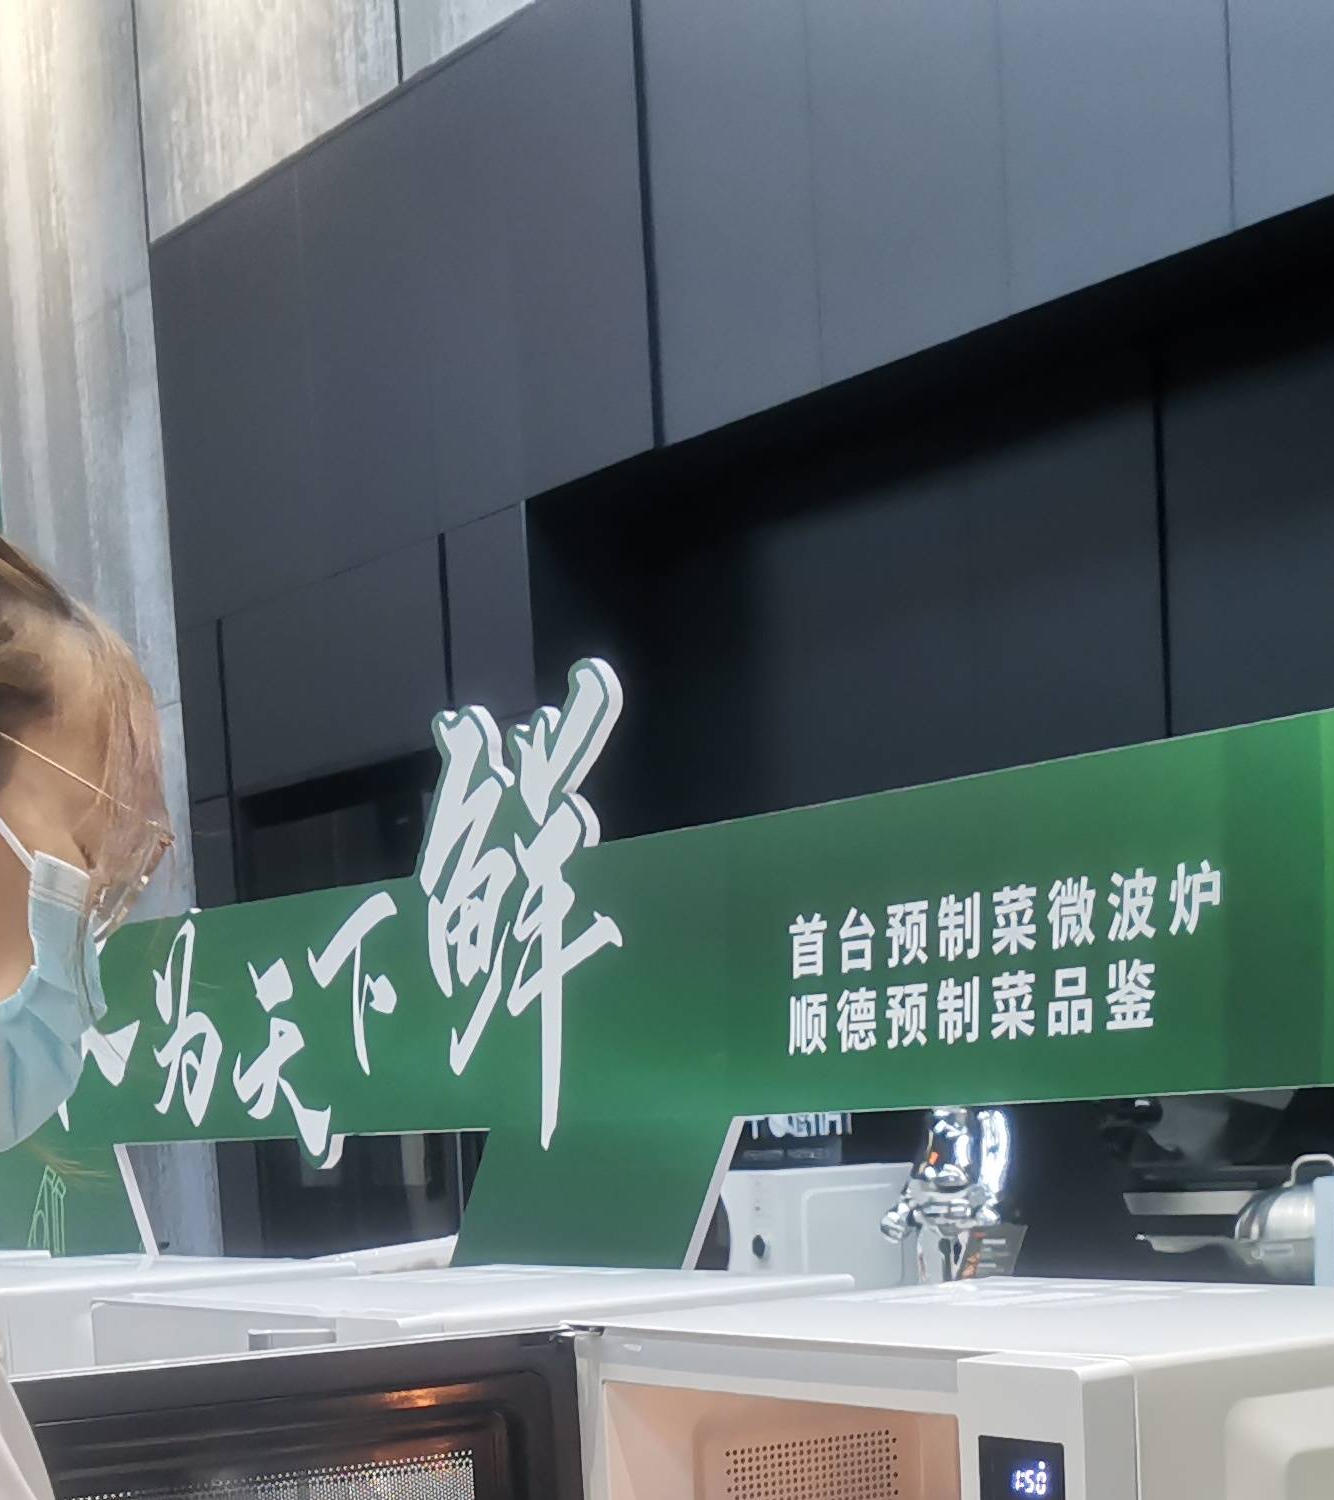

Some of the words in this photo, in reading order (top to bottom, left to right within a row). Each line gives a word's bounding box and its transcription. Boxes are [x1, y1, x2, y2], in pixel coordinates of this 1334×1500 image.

[56, 658, 623, 1158] 为天下鲜
[788, 859, 1222, 980] 首台预制菜微波炉
[788, 958, 1156, 1056] 顺德预制菜品鉴
